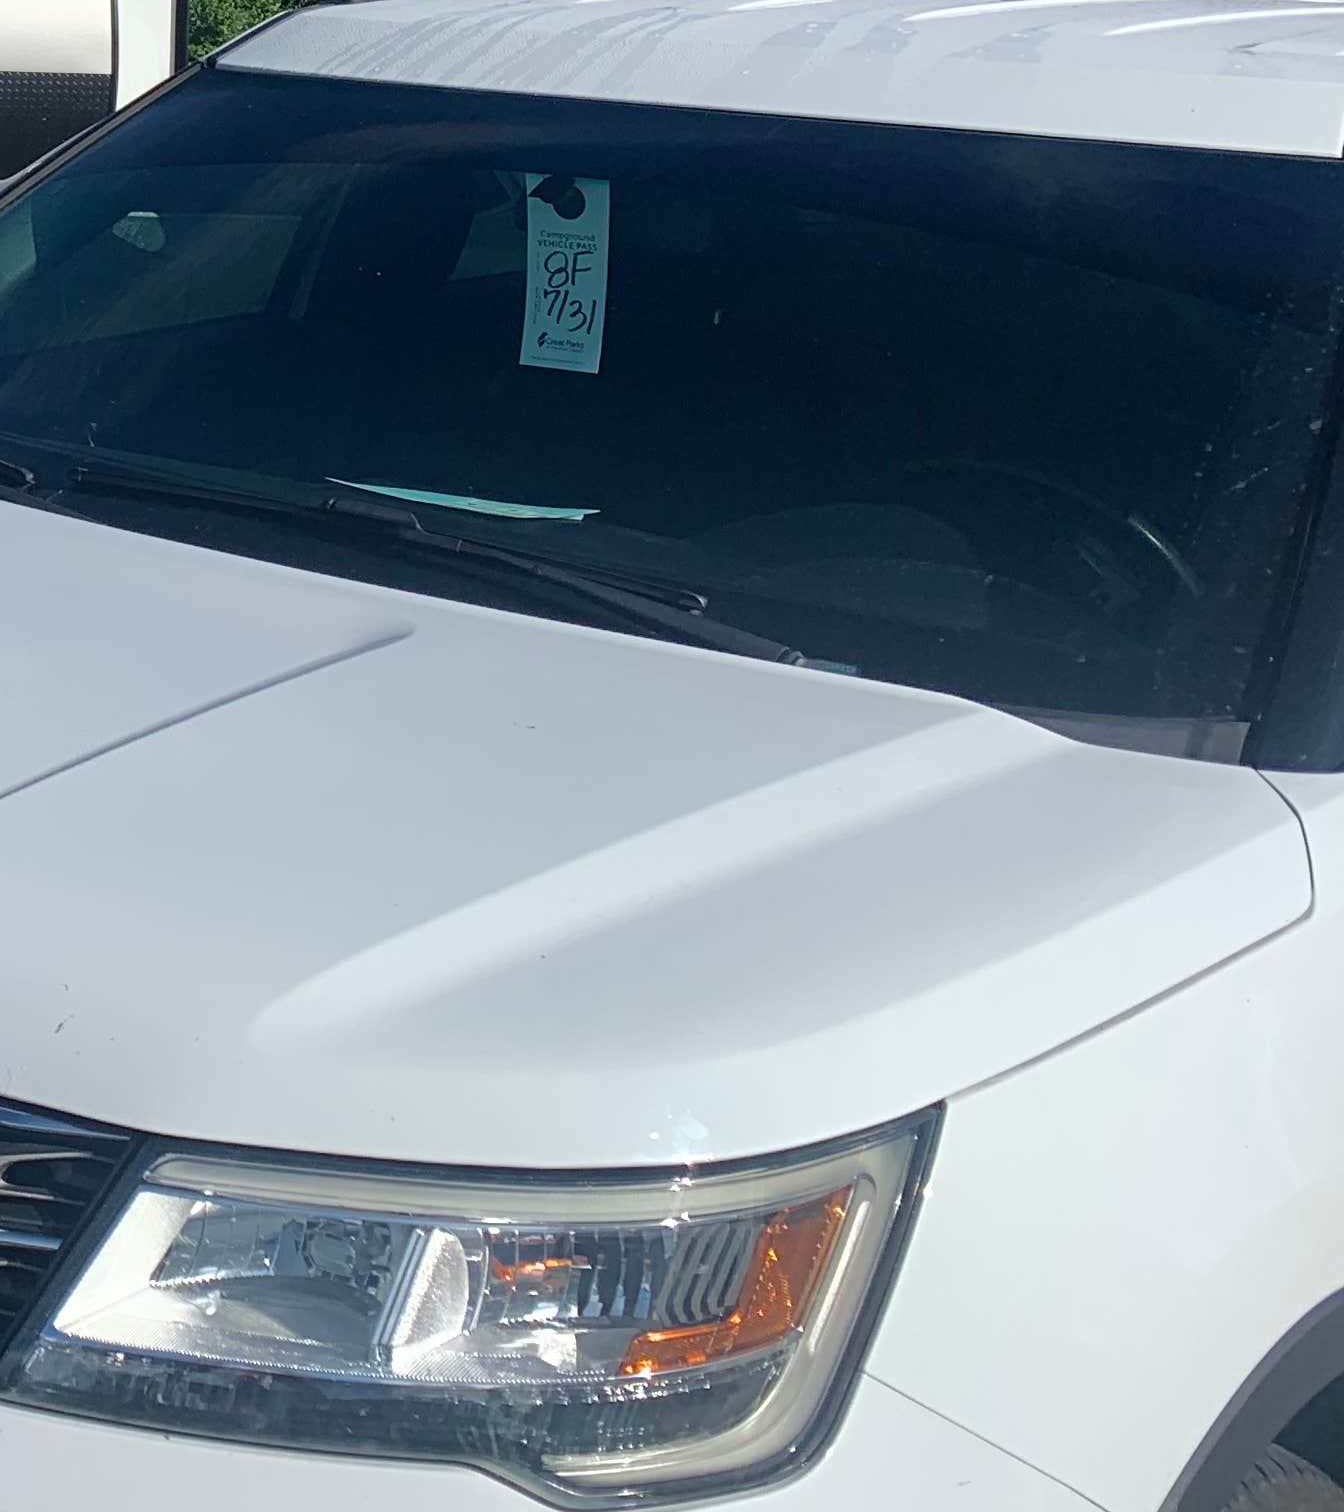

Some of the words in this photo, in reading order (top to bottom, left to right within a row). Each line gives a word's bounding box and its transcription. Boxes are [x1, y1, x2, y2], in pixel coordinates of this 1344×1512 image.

[537, 239, 574, 249] VEHICLE
[576, 242, 598, 251] PASS
[544, 250, 594, 289] 8F
[543, 289, 597, 335] 7/31
